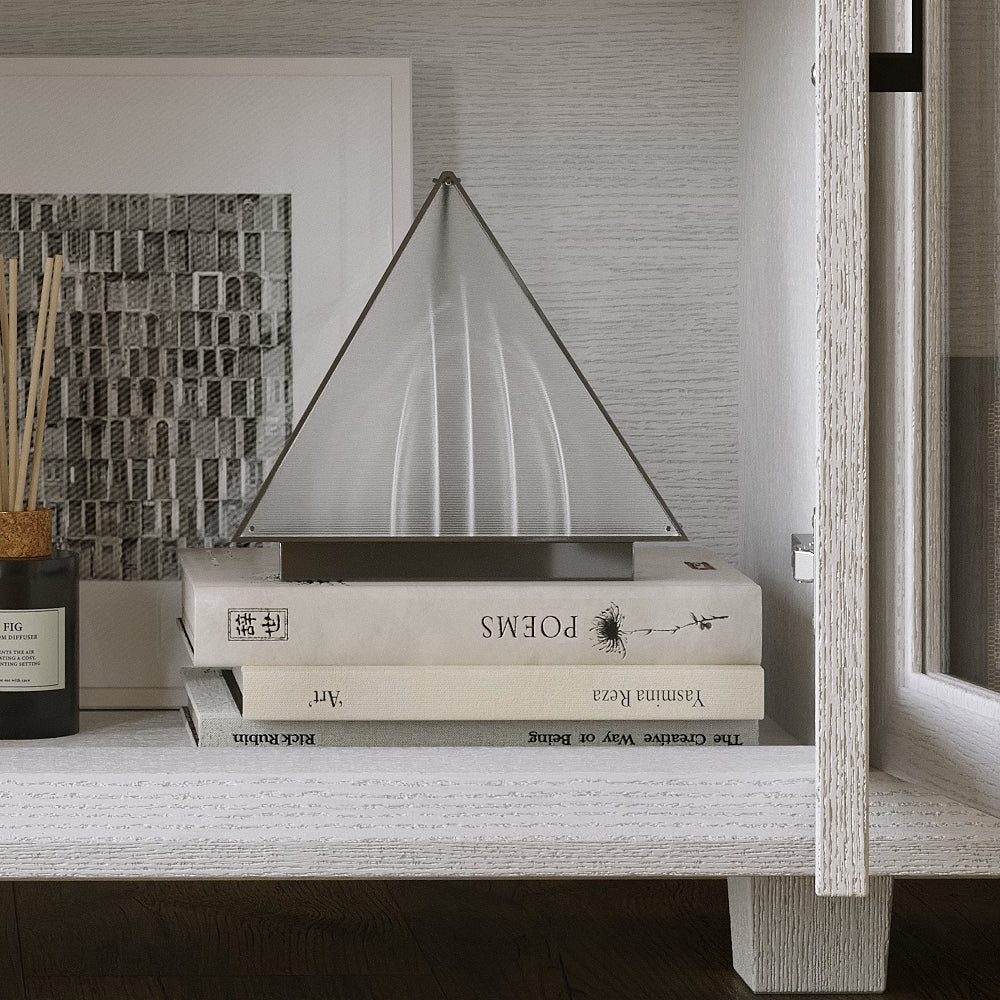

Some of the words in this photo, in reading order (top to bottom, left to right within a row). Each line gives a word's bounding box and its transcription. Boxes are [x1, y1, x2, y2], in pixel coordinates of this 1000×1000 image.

[3, 622, 23, 632] FIG
[481, 615, 578, 639] POEMS
[592, 688, 630, 708] Reza
[636, 688, 705, 708] Yasmina
[232, 732, 279, 745] Rubin
[281, 732, 316, 745] Rick
[528, 731, 572, 746] Being
[601, 731, 636, 746] Way
[643, 733, 707, 746] Creative
[713, 733, 744, 746] The
